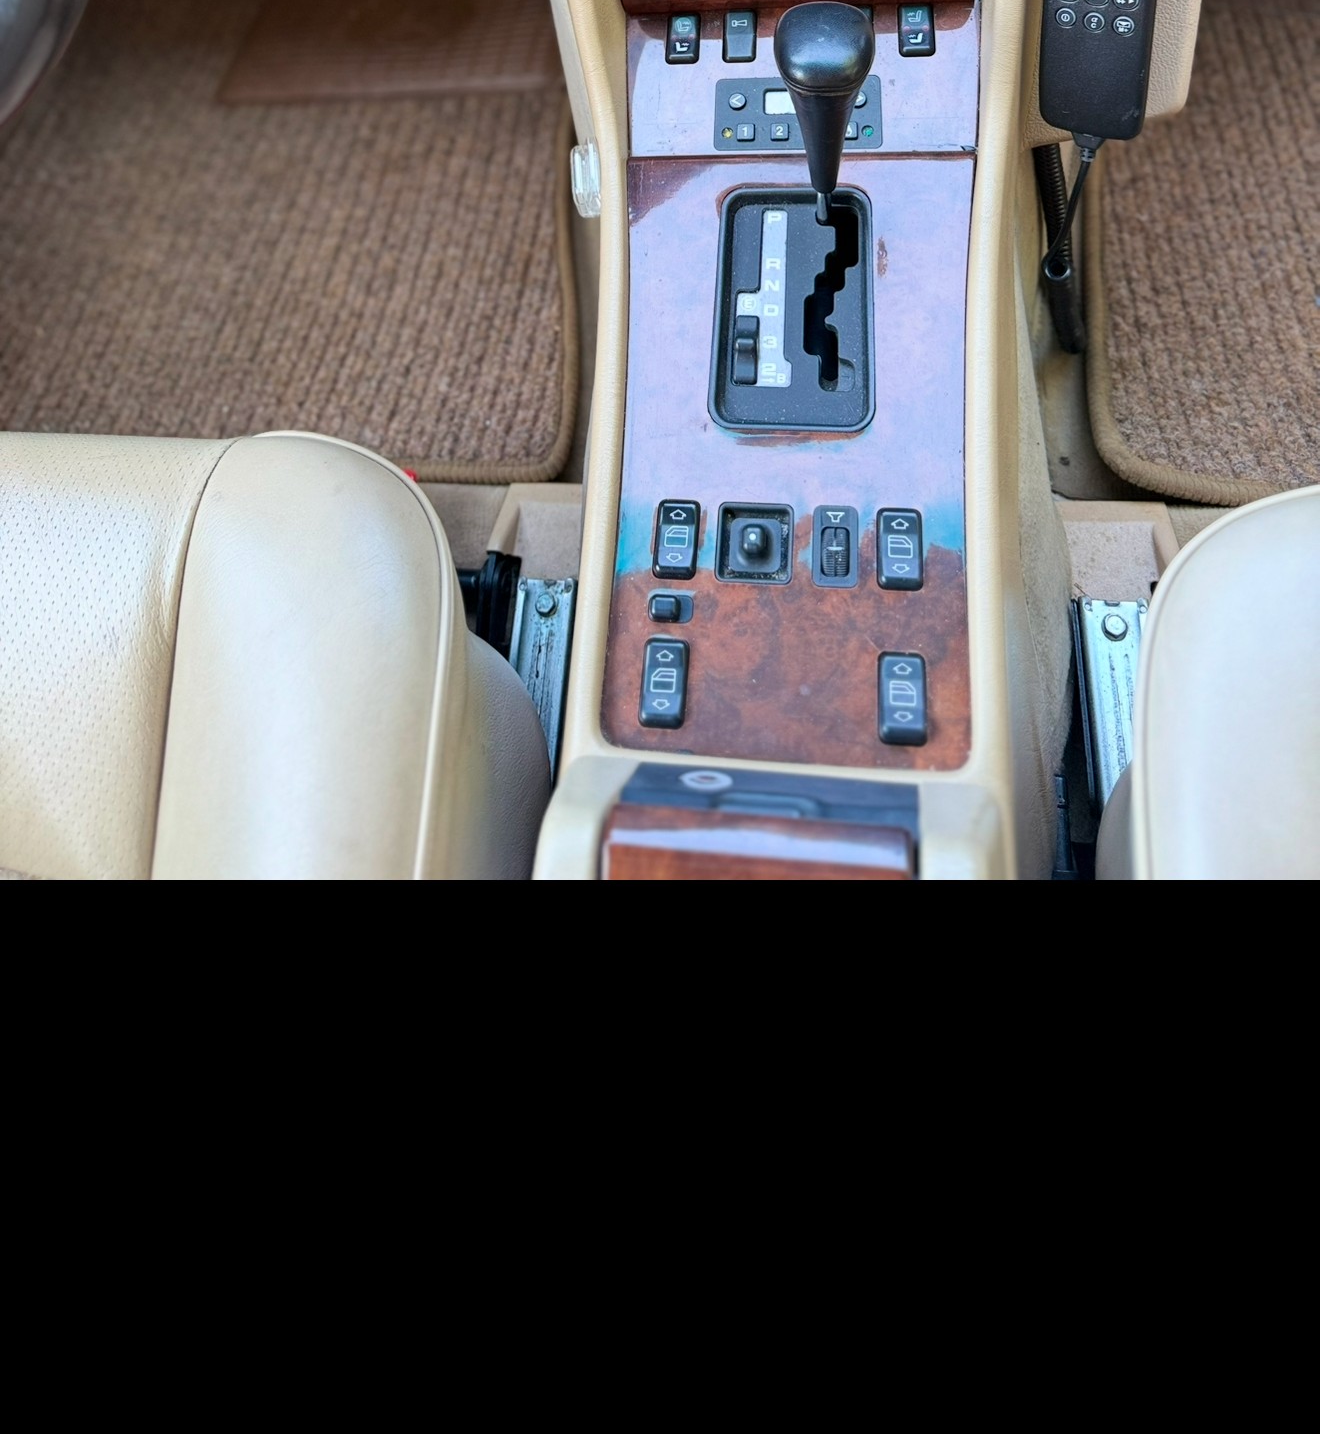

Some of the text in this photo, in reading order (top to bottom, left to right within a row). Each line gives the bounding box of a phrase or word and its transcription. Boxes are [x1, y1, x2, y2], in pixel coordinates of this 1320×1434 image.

[742, 127, 748, 136] 1
[776, 126, 783, 135] 2
[768, 212, 782, 224] P
[766, 258, 780, 269] R
[765, 280, 779, 291] N
[764, 304, 779, 316] D
[763, 336, 777, 349] 3
[762, 363, 776, 376] 2
[777, 373, 786, 384] B
